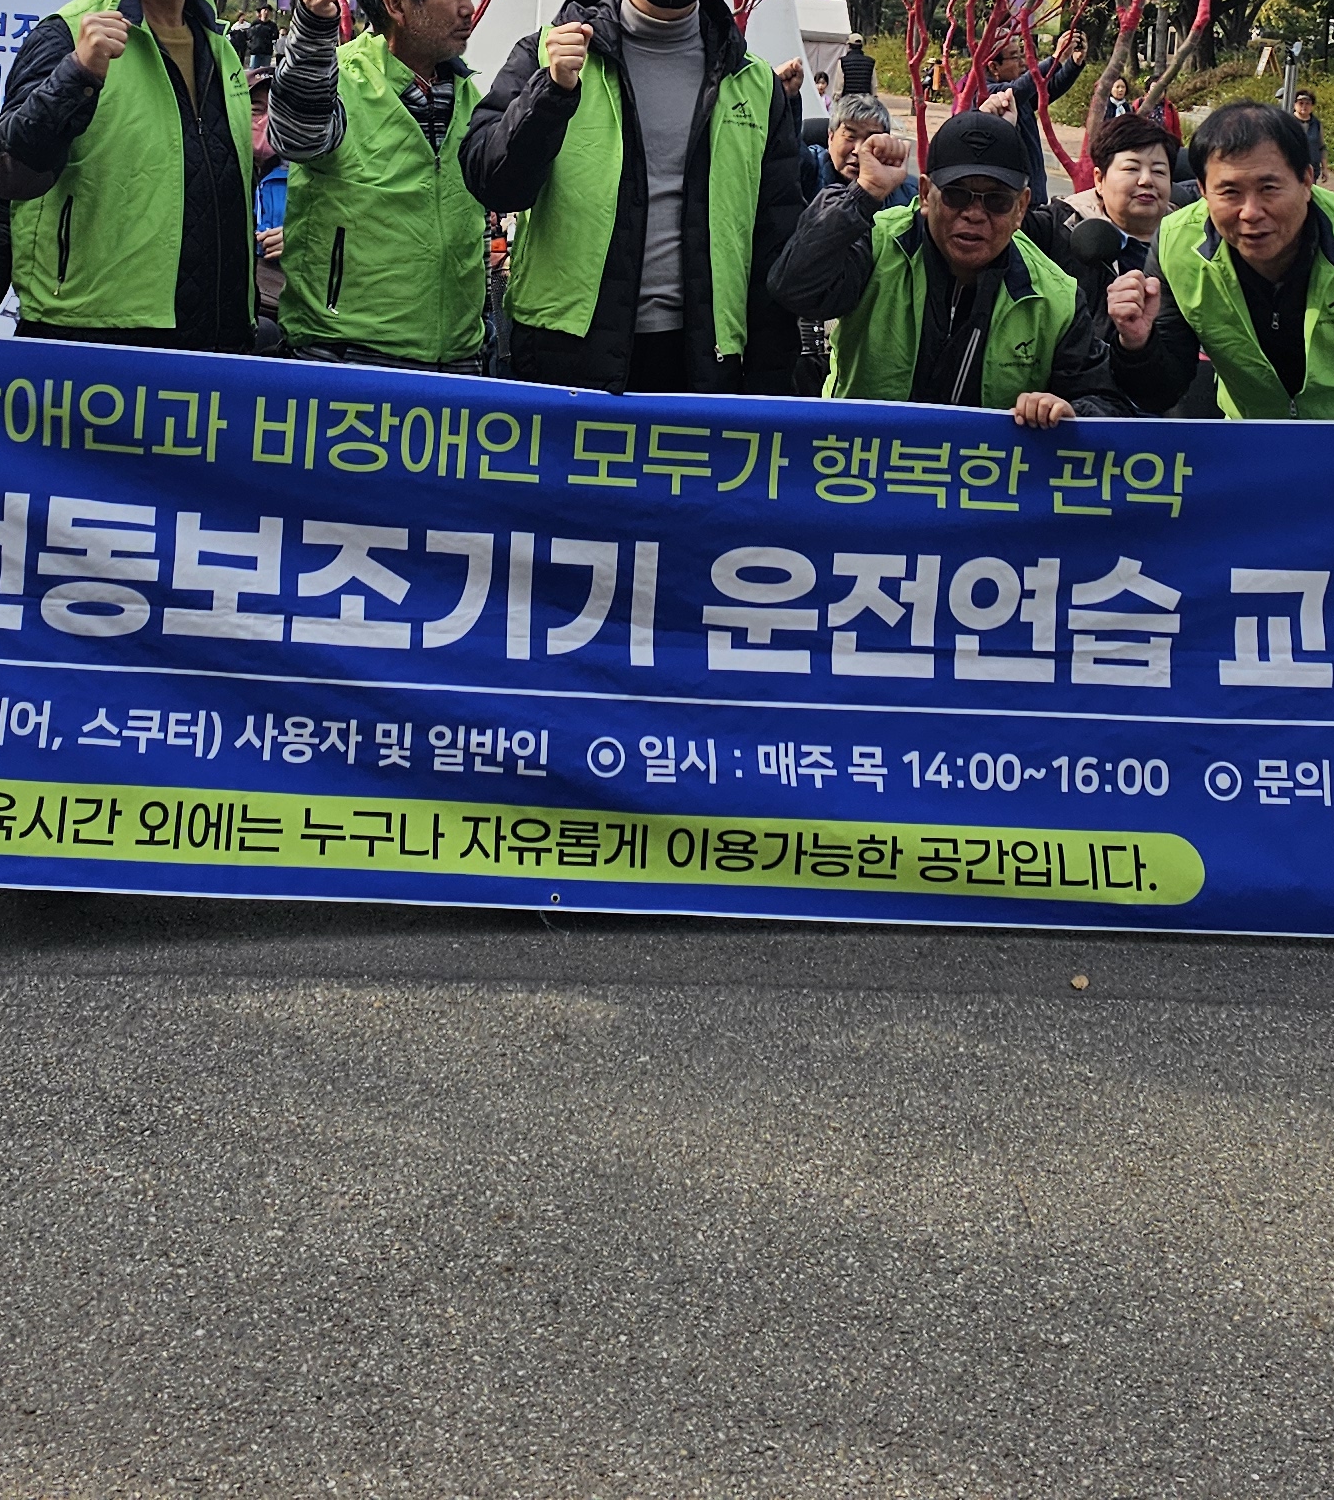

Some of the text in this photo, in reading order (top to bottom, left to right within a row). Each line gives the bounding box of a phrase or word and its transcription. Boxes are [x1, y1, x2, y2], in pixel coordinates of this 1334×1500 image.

[253, 398, 541, 482] 비장애인
[569, 421, 786, 498] 모두가
[814, 435, 1028, 510] 행복한
[1050, 451, 1191, 516] 관악
[703, 547, 1181, 687] 운전연습
[78, 708, 222, 759] 스쿠터)
[234, 714, 362, 764] 사용자
[376, 723, 412, 767] 및
[429, 726, 548, 776] 일반인
[639, 736, 716, 784] 일시
[758, 742, 837, 788] 매주
[848, 746, 887, 792] 목
[903, 751, 1169, 795] 14:00~16:00
[1254, 760, 1331, 806] 문의
[137, 800, 283, 852] 외에는
[301, 808, 445, 859] 누구나
[459, 814, 648, 869] 자유롭게
[666, 826, 903, 880] 이용가능한
[917, 834, 1159, 892] 공간입니다.
